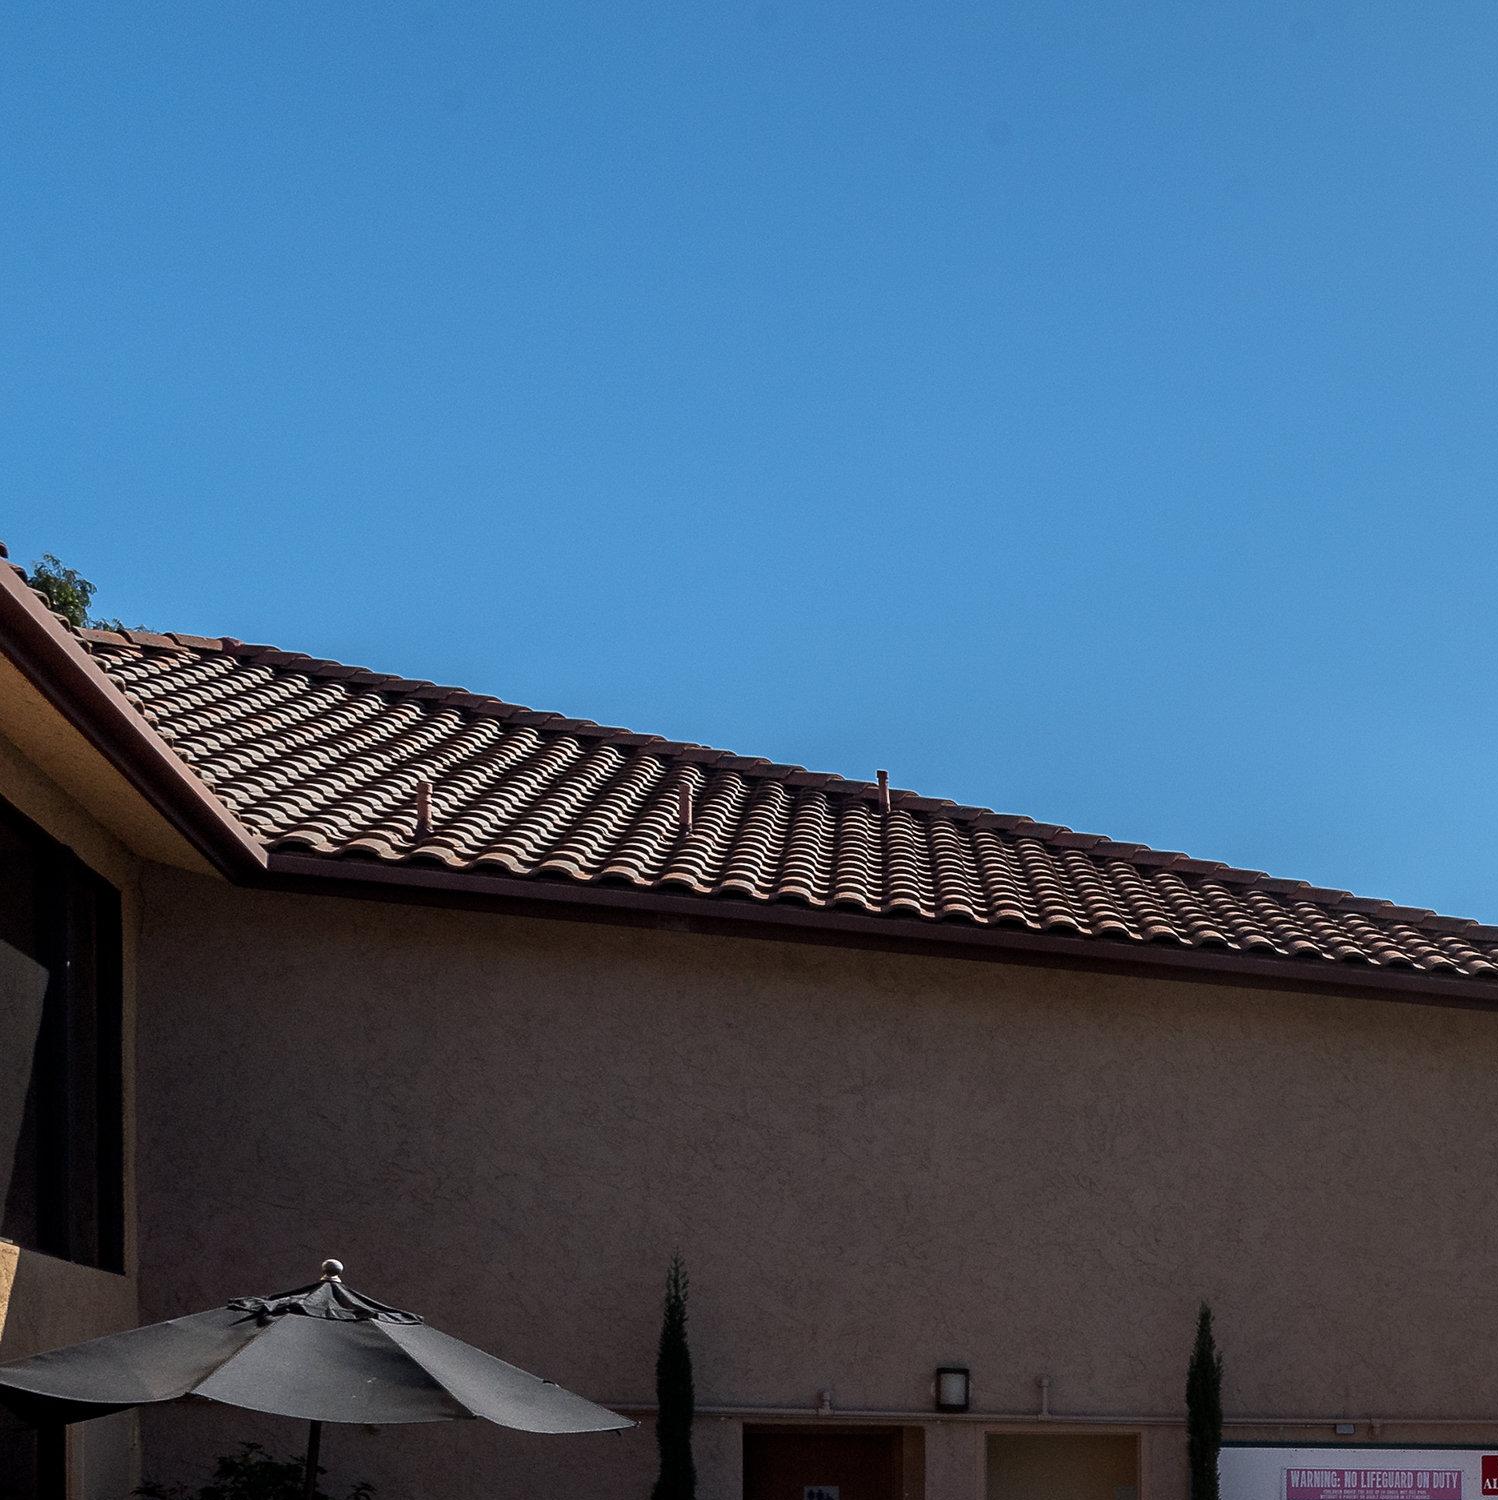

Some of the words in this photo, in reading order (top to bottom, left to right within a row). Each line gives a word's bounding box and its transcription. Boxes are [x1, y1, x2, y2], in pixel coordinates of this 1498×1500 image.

[1290, 1470, 1341, 1488] WARNING:
[1344, 1471, 1357, 1488] NO
[1360, 1471, 1414, 1489] LIFEGUARD
[1416, 1471, 1430, 1489] ON
[1432, 1471, 1458, 1489] DUTY
